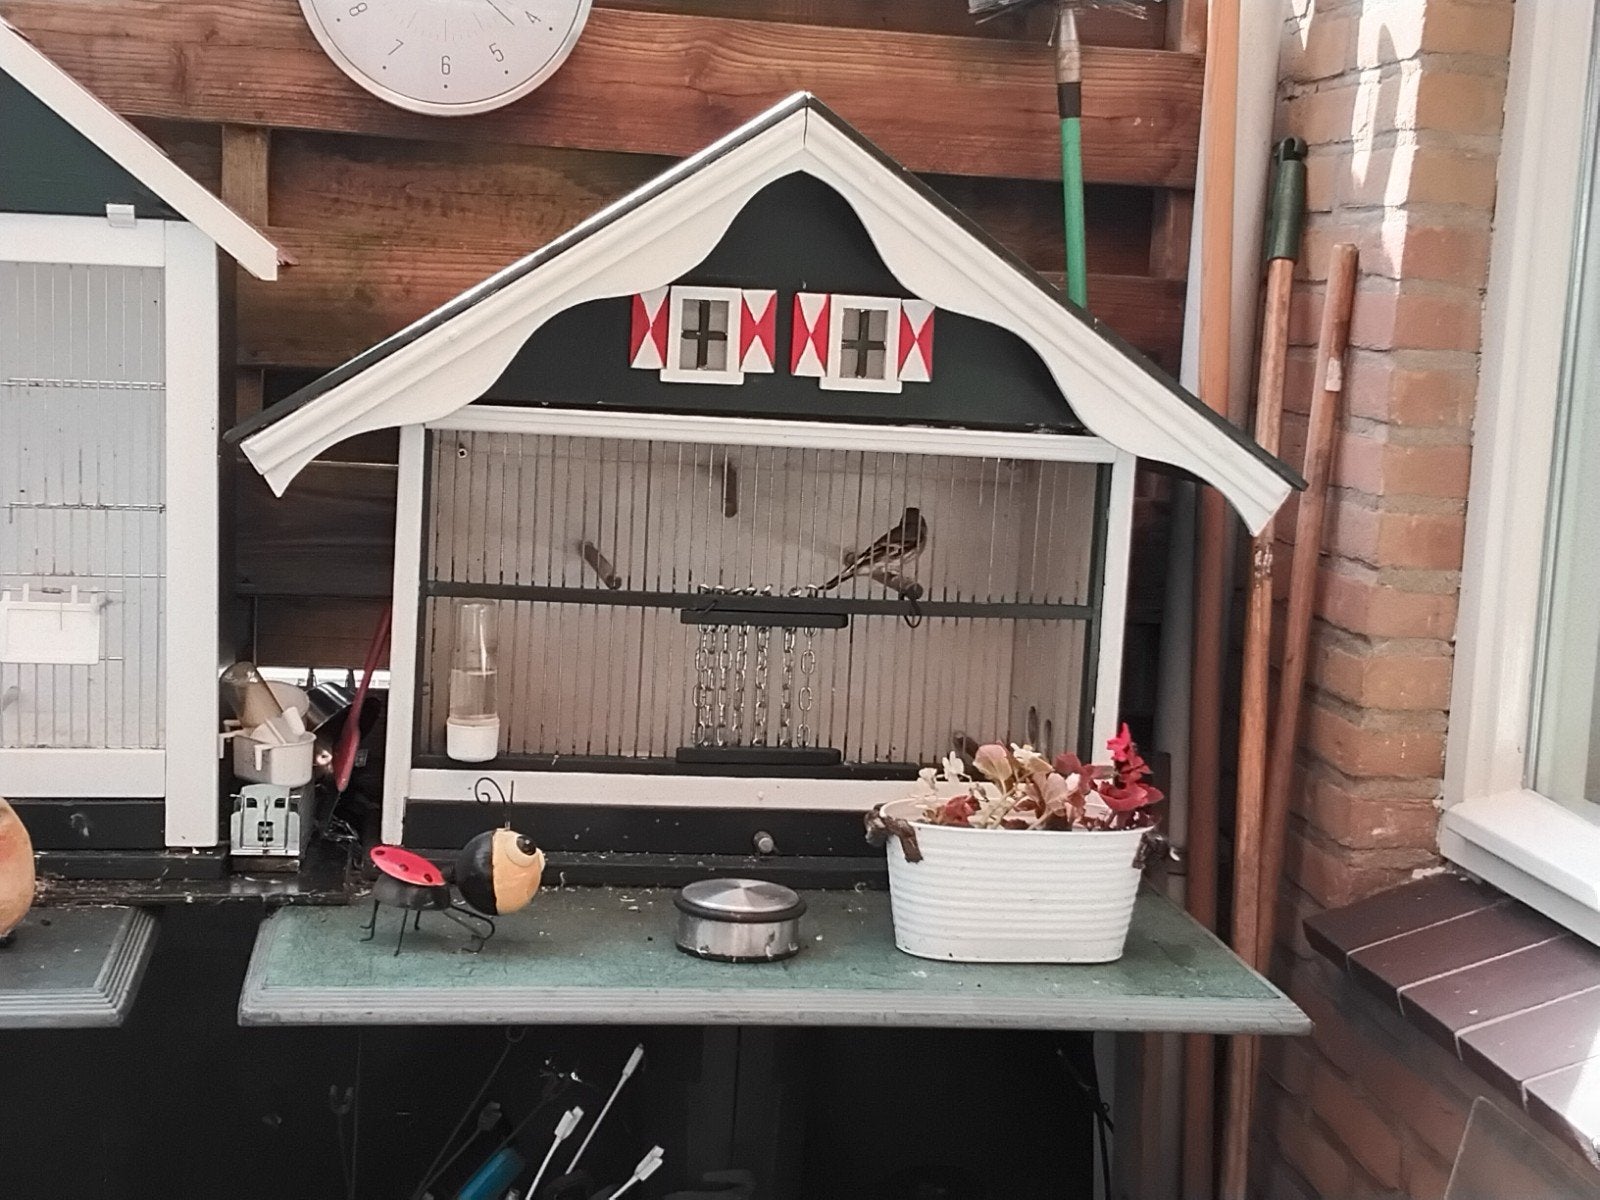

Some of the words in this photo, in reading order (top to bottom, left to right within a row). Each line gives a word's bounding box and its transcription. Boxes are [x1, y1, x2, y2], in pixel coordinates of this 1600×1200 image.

[349, 2, 368, 17] 8
[525, 10, 542, 24] 4
[388, 38, 404, 56] 7
[488, 42, 504, 62] 5
[441, 55, 451, 75] 6
